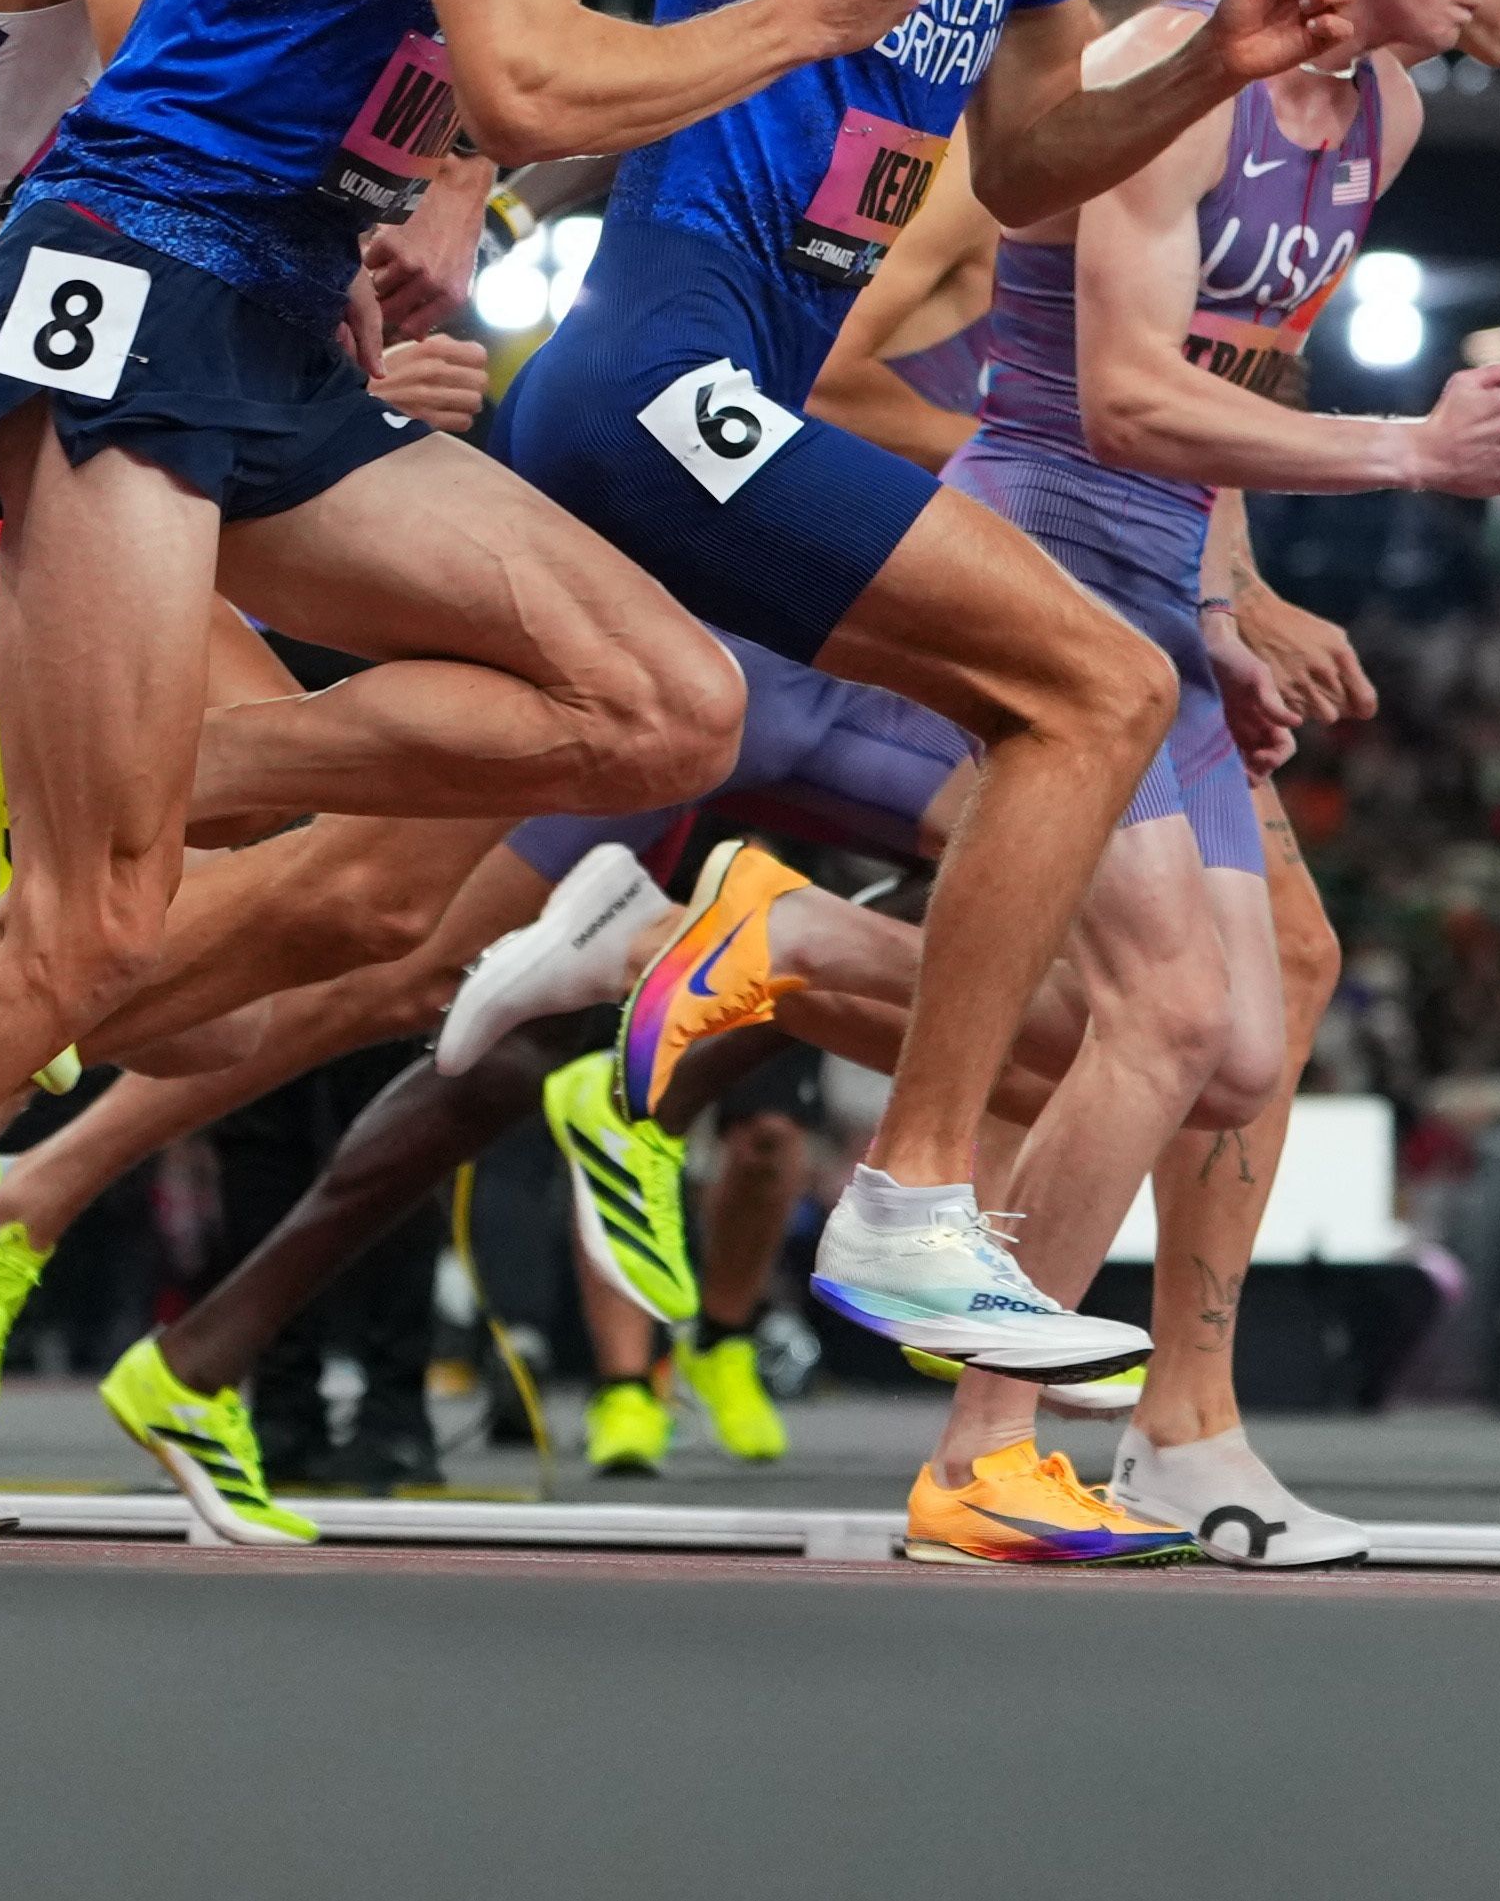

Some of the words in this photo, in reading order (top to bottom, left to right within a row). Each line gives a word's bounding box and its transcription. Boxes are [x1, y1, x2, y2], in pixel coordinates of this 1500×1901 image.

[1200, 216, 1356, 312] USA
[33, 279, 104, 371] 8
[695, 381, 763, 460] 6
[967, 1292, 1050, 1315] BROO
